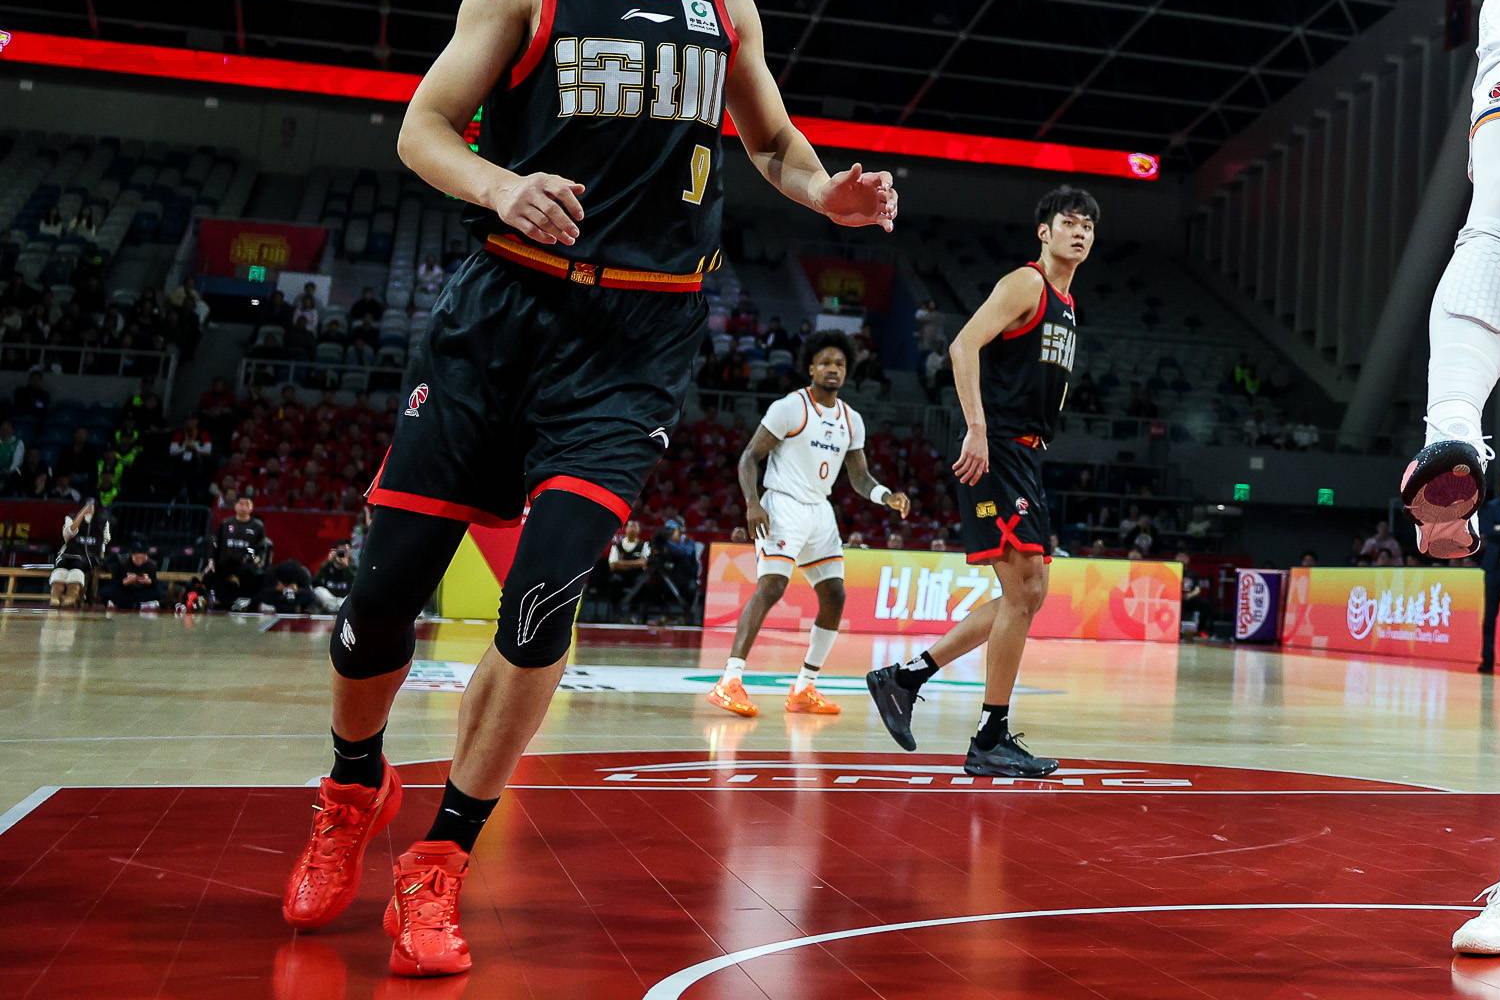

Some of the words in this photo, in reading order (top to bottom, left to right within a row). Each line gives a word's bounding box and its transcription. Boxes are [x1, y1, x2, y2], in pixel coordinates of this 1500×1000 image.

[554, 36, 728, 129] 深圳
[819, 461, 829, 481] 0
[874, 565, 1004, 622] 以城之
[602, 773, 1193, 787] LI-NING
